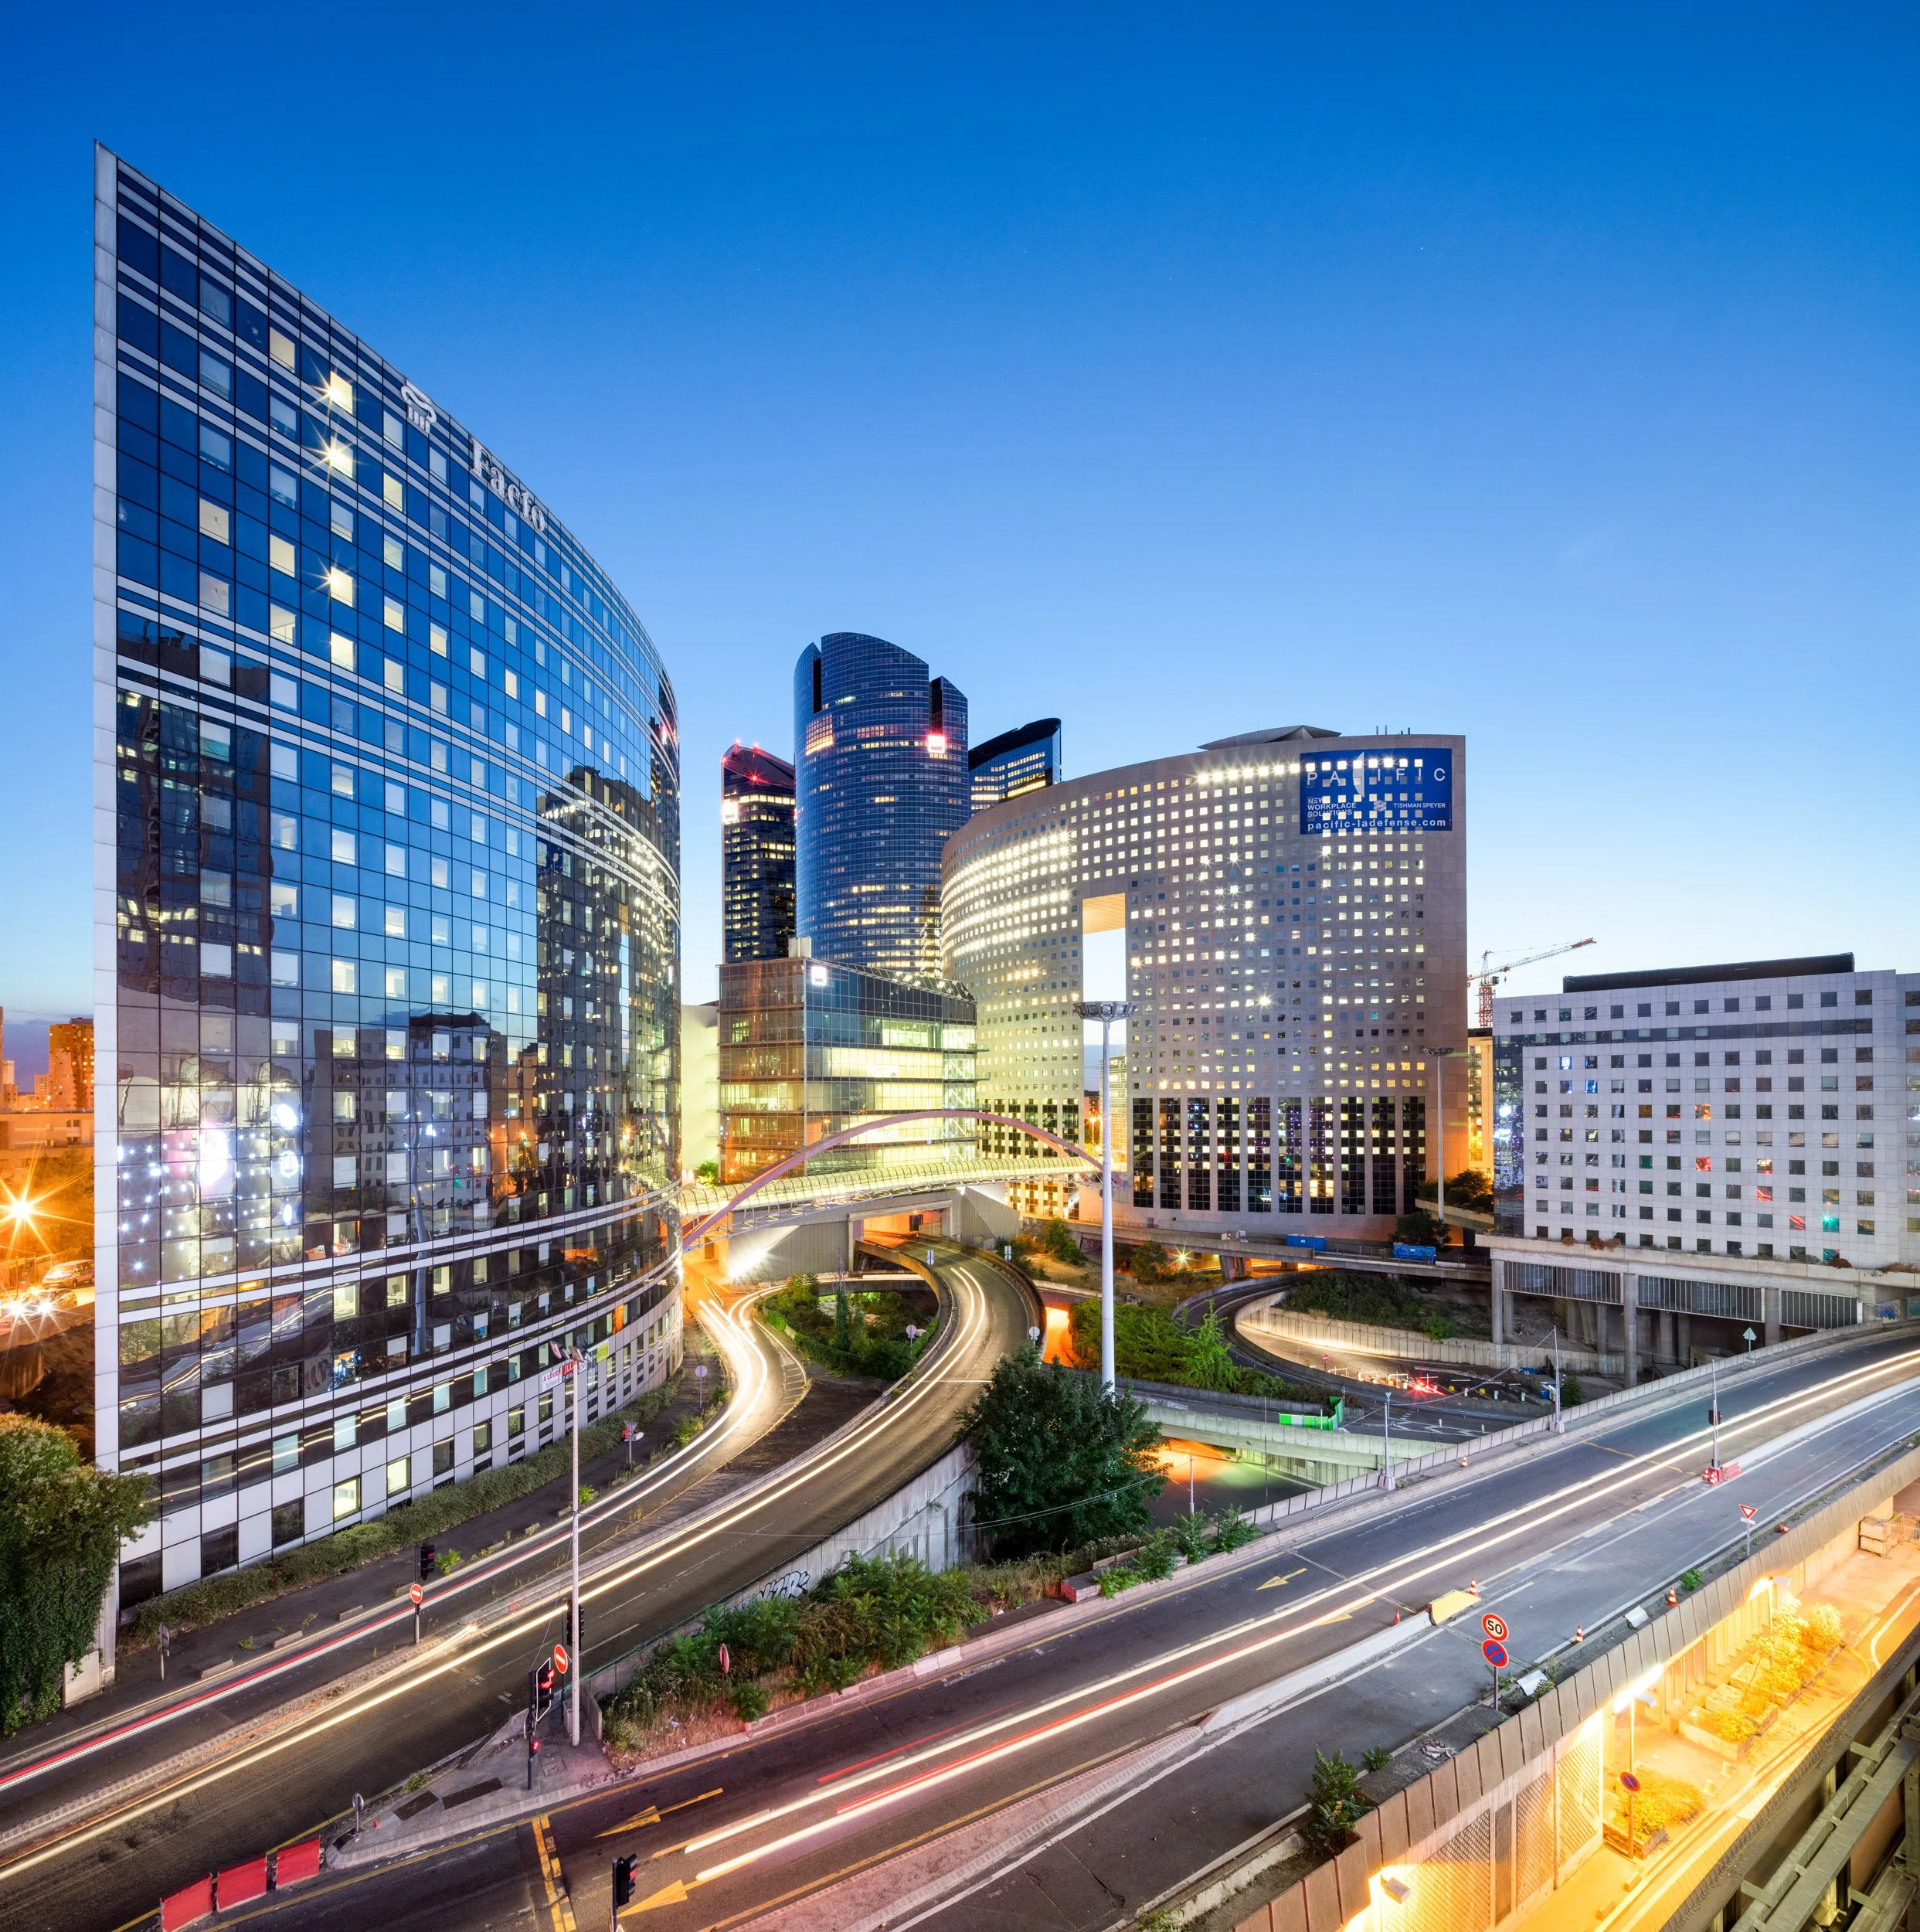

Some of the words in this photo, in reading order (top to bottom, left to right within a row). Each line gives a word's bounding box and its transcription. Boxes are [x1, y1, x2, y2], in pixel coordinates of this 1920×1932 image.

[470, 437, 546, 532] Facto
[1307, 802, 1357, 811] WORKPLACE
[1307, 819, 1446, 832] pacific-ladefense.com
[1487, 1620, 1503, 1634] 50
